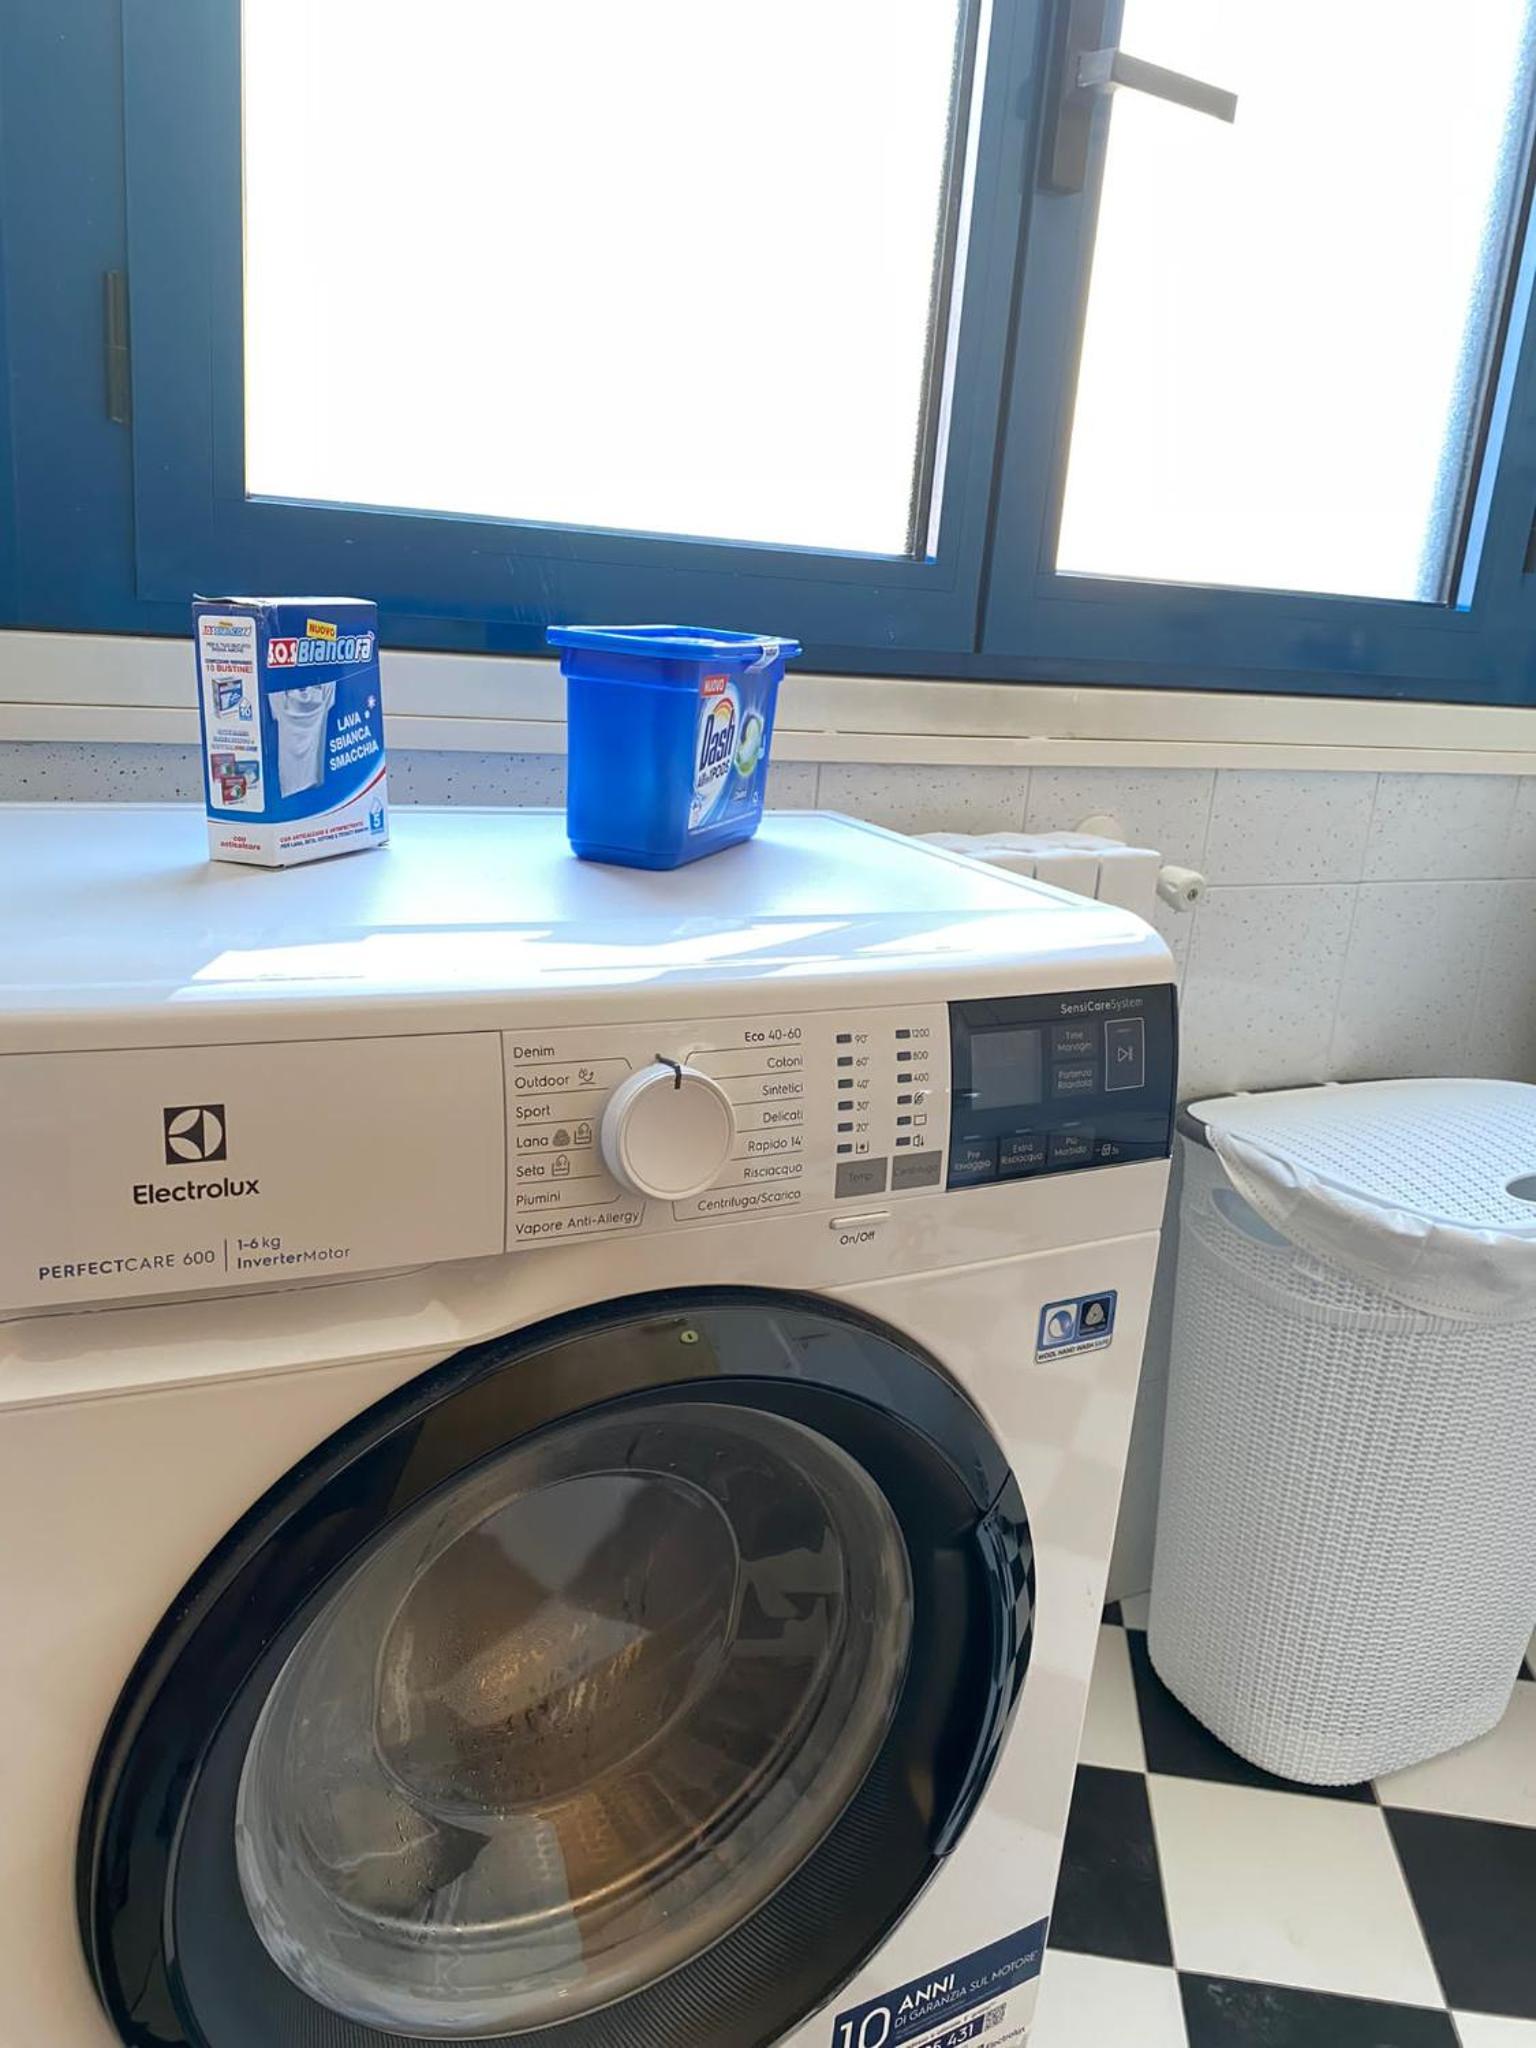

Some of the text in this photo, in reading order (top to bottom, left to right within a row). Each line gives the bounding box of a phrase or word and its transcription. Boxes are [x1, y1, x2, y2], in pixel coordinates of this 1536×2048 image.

[309, 623, 336, 637] NUOVO
[337, 712, 362, 731] LAVA
[329, 725, 372, 753] SBIANCA
[699, 708, 736, 771] Dash
[329, 740, 380, 771] SMACCHIA
[744, 1028, 802, 1043] Eco 40-60
[911, 1028, 930, 1038] 1200
[513, 1046, 556, 1059] Denim
[912, 1051, 929, 1061] 800
[767, 1057, 803, 1069] Cotoni
[514, 1075, 570, 1090] Outdoor
[913, 1073, 929, 1082] 400
[762, 1084, 804, 1097] Sintetici
[515, 1105, 551, 1121] Sport
[762, 1110, 804, 1124] Delicati
[516, 1135, 549, 1149] Lana
[747, 1138, 788, 1153] Rapido
[515, 1165, 545, 1178] Seta
[133, 1177, 260, 1205] Electrolux
[515, 1191, 561, 1207] Piumini
[697, 1189, 802, 1212] Centrifuga/Scarico
[515, 1210, 640, 1236] Vapore Anti-Allergy
[237, 1235, 281, 1252] 1-6 kg
[840, 1230, 876, 1246] On/Off
[38, 1249, 216, 1281] PERFECTCARE 600
[237, 1247, 352, 1270] InverterMotor
[840, 2006, 891, 2048] 10
[897, 1973, 956, 2015] ANNI
[894, 2015, 907, 2030] DI
[909, 1987, 967, 2023] GARANZIA
[969, 1978, 990, 1993] SUL
